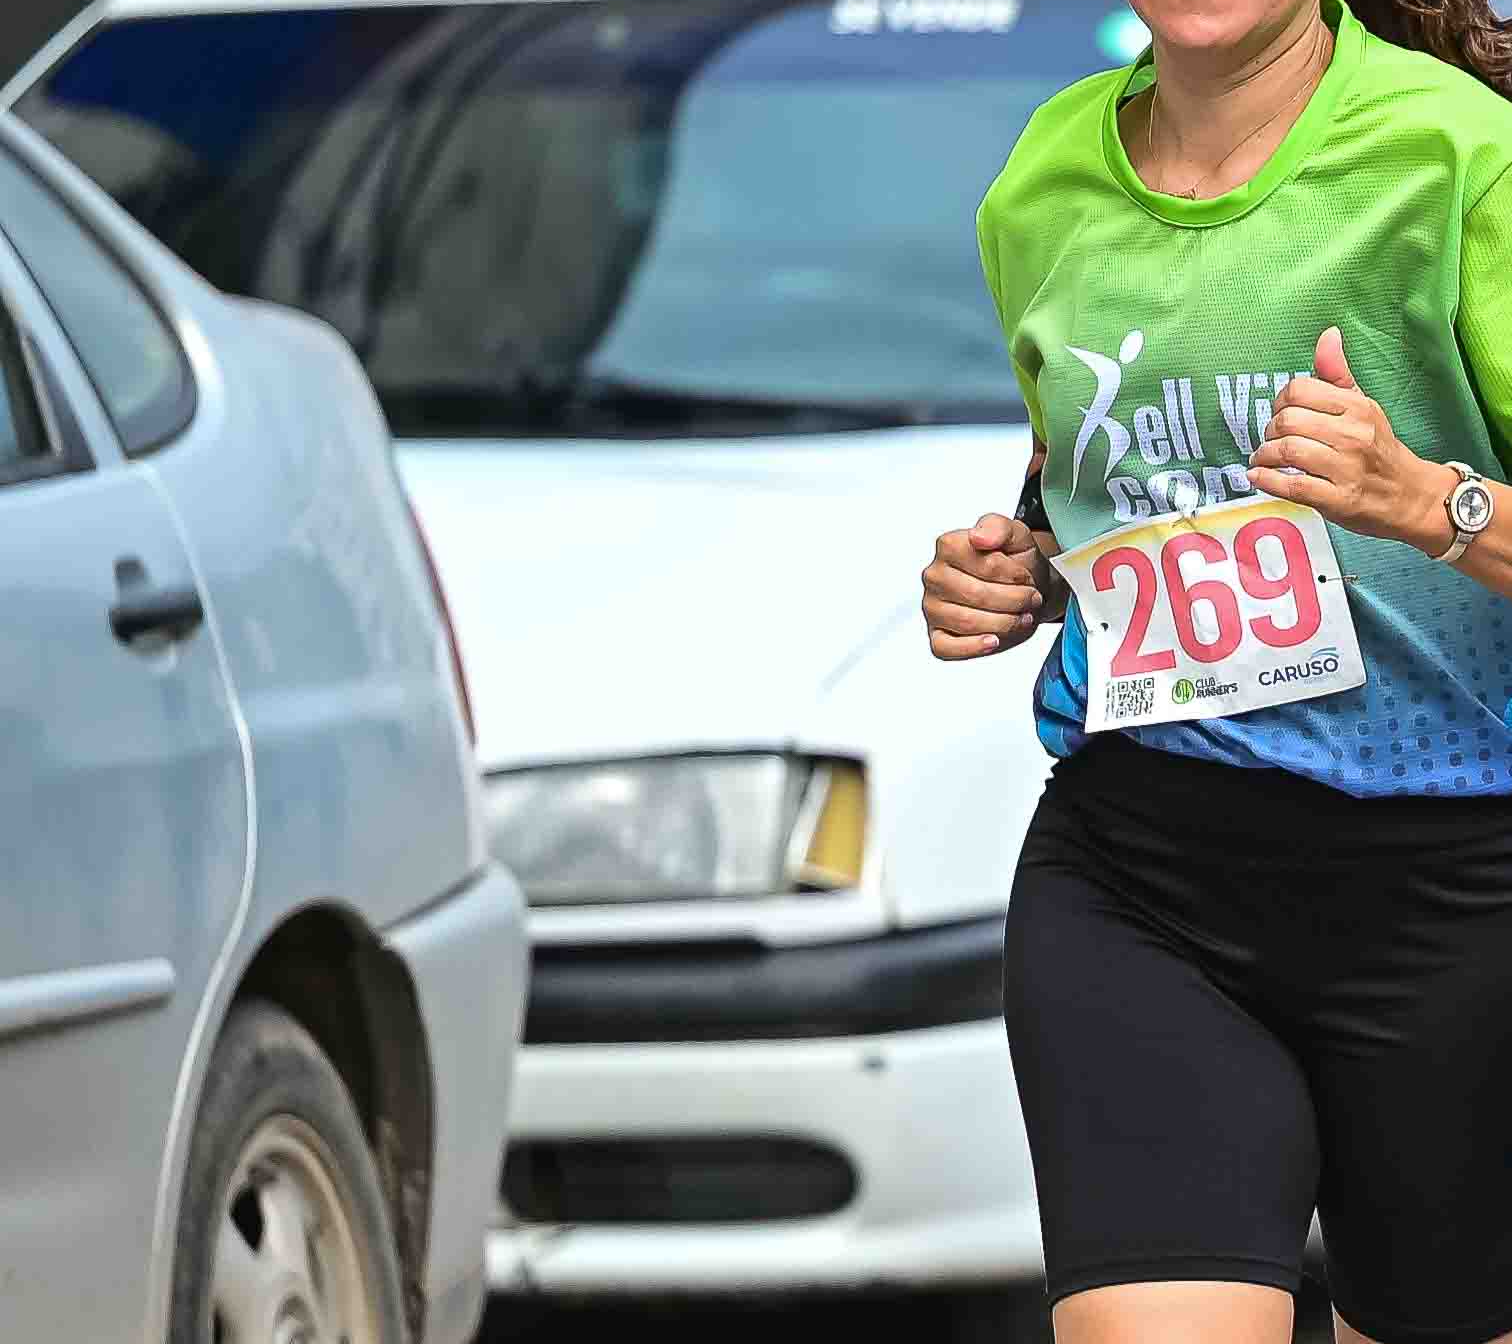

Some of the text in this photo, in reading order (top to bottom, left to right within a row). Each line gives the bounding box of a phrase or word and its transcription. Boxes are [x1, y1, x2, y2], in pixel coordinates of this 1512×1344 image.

[1106, 463, 1306, 522] cor
[1091, 516, 1324, 678] 269
[1257, 657, 1340, 687] CARUSO
